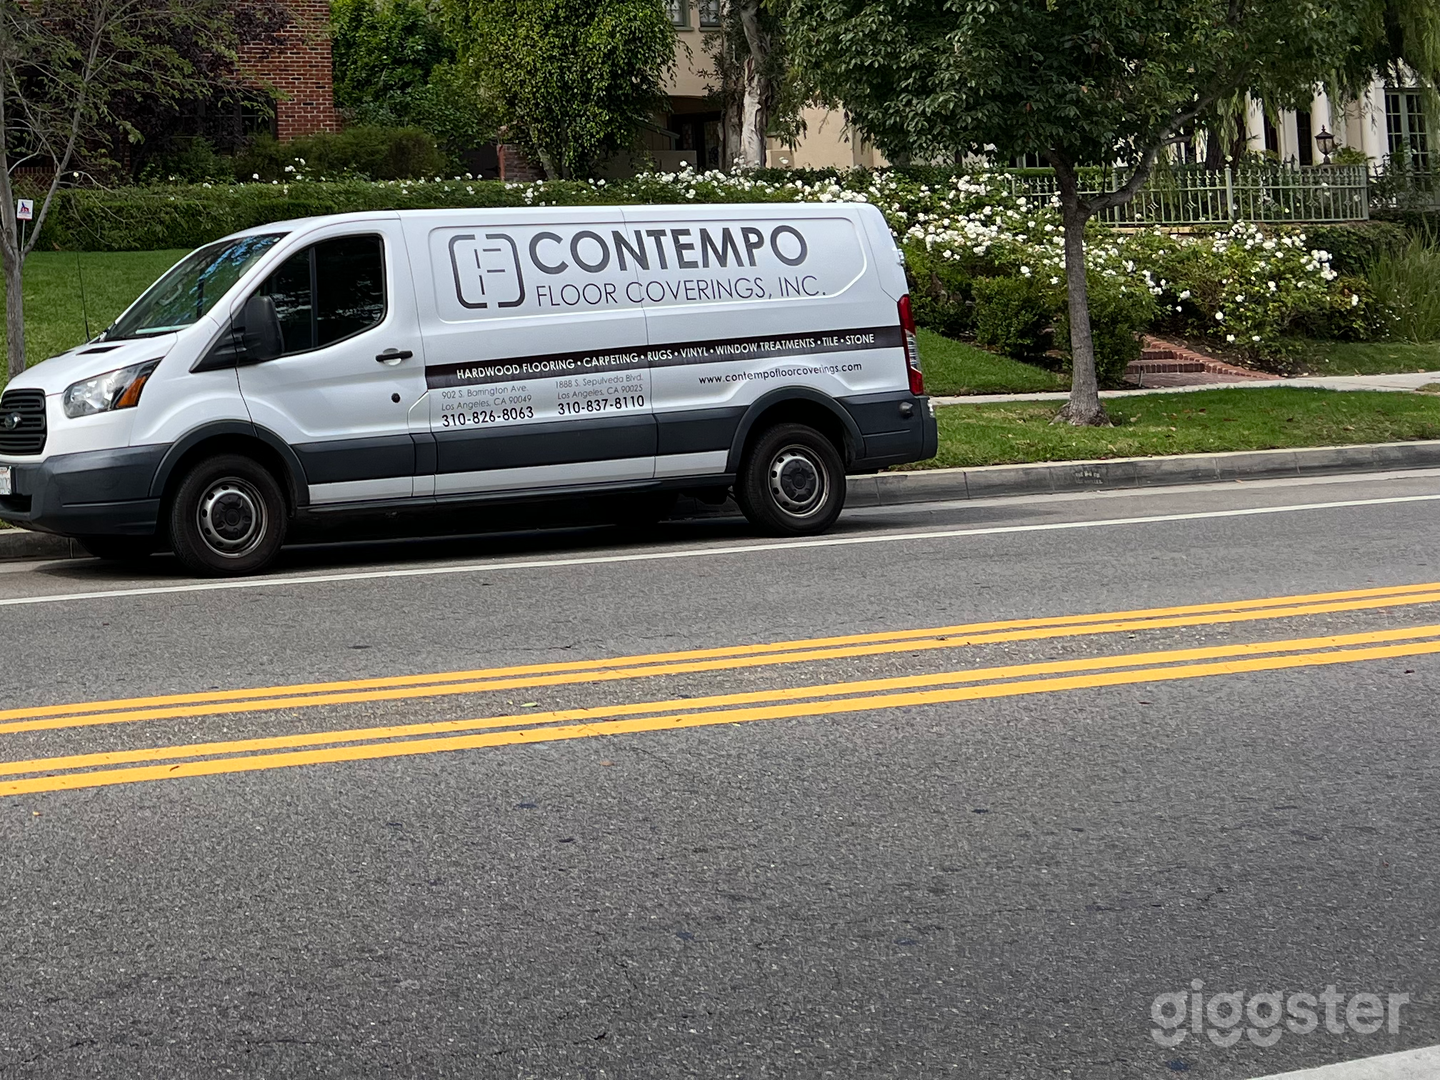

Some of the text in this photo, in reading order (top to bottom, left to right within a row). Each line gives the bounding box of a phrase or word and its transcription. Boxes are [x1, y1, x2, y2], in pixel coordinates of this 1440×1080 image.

[529, 225, 808, 275] CONTEMPO
[536, 275, 826, 307] FLOOR COVERINGS, INC.
[456, 333, 875, 379] HARDWOOD FLOORING CARPETING RUGS VINYL WINDOW TREATMENTS TILE STONE
[555, 372, 644, 389] 1888 S. Sepulveda Blvd.
[698, 362, 863, 385] www.contempofloorcoverings.com
[441, 390, 456, 400] 902
[458, 389, 464, 399] S.
[510, 384, 529, 394] Ave.
[557, 390, 570, 400] Los
[606, 385, 620, 396] CA
[621, 382, 644, 394] 90025
[441, 401, 455, 412] Los
[493, 396, 508, 407] CA
[508, 393, 533, 405] 90049
[557, 394, 646, 416] 310-837-8110
[441, 405, 535, 428] 310-826-8063
